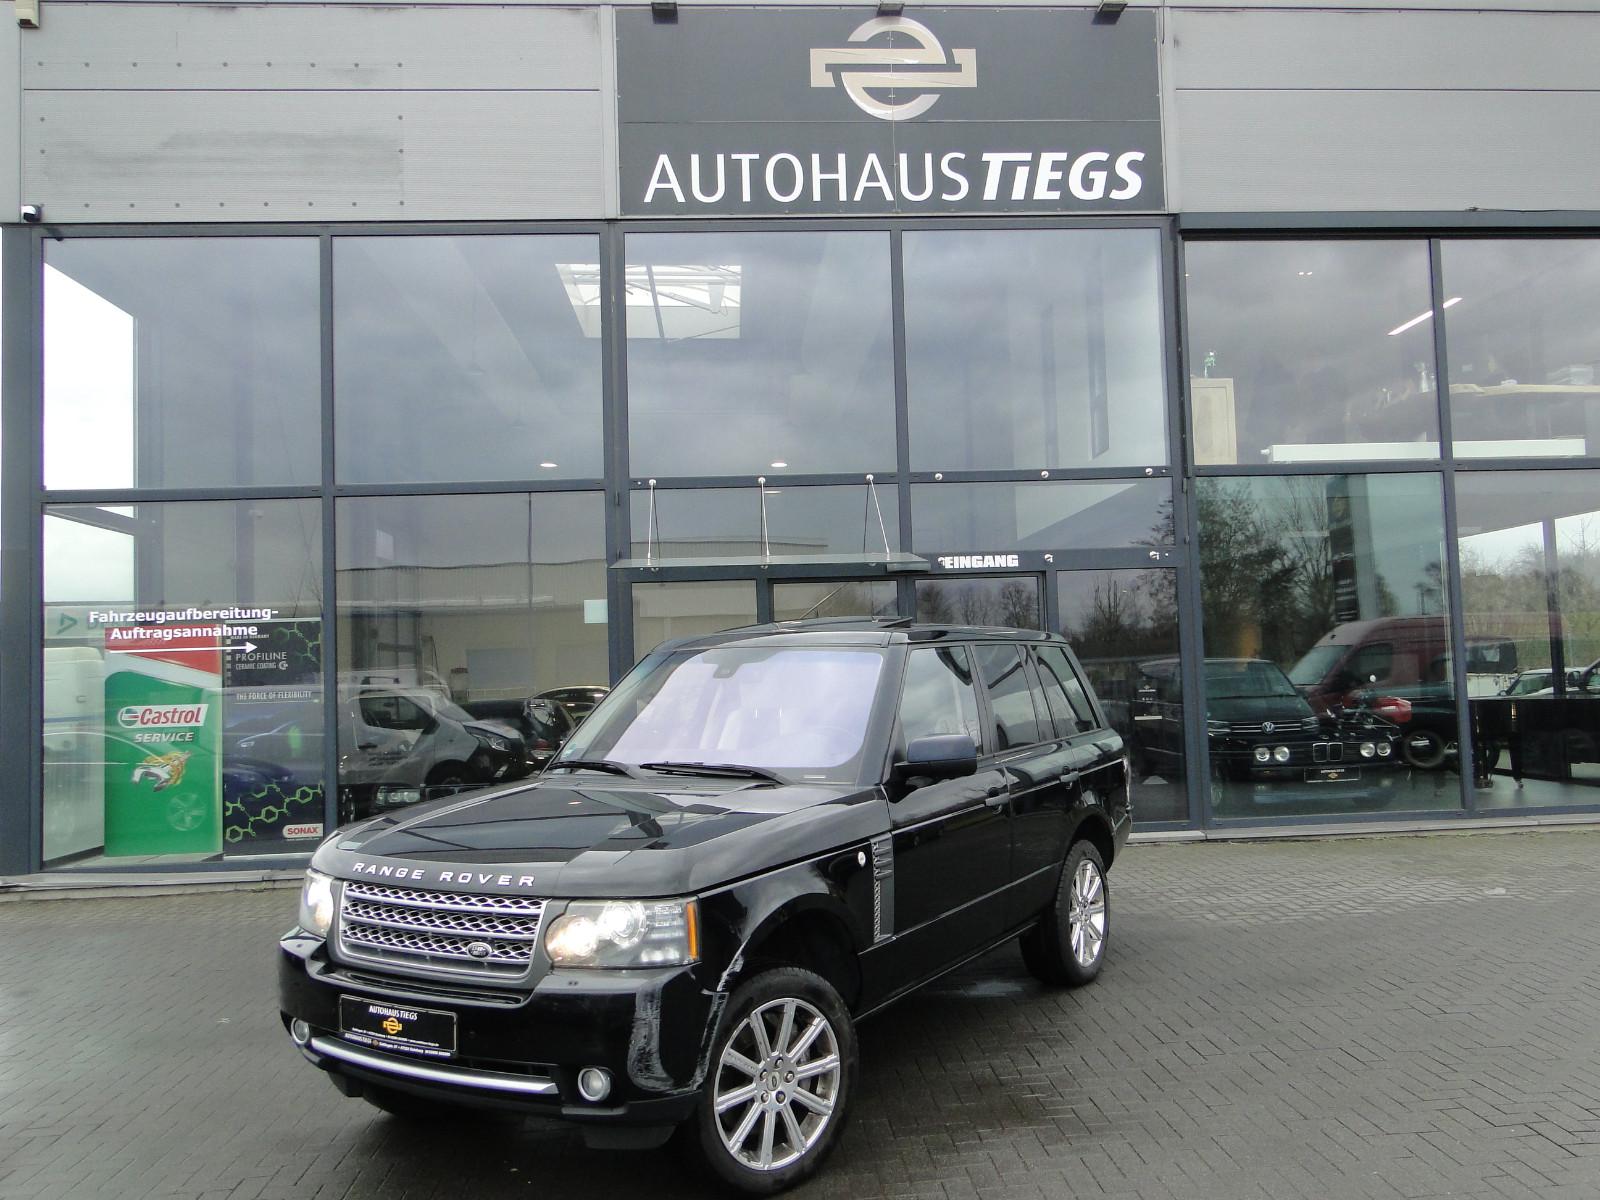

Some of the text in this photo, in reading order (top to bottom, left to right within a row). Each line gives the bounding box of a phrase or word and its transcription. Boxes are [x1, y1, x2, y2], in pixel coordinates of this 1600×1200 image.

[643, 152, 969, 203] AUTOHAUS
[944, 554, 1019, 569] EINGANG
[89, 607, 279, 624] Fahrzeugaufbereitung-
[110, 624, 258, 641] Auftragsannahme
[235, 651, 288, 662] PROFILINE
[236, 689, 313, 701] THE FORCE OF FLEXIBILITY
[140, 707, 202, 725] Castrol
[134, 732, 194, 743] SERVICE
[287, 826, 319, 836] SONAX
[352, 862, 535, 887] RANGE ROVER
[369, 1005, 400, 1018] AUTOHAUS
